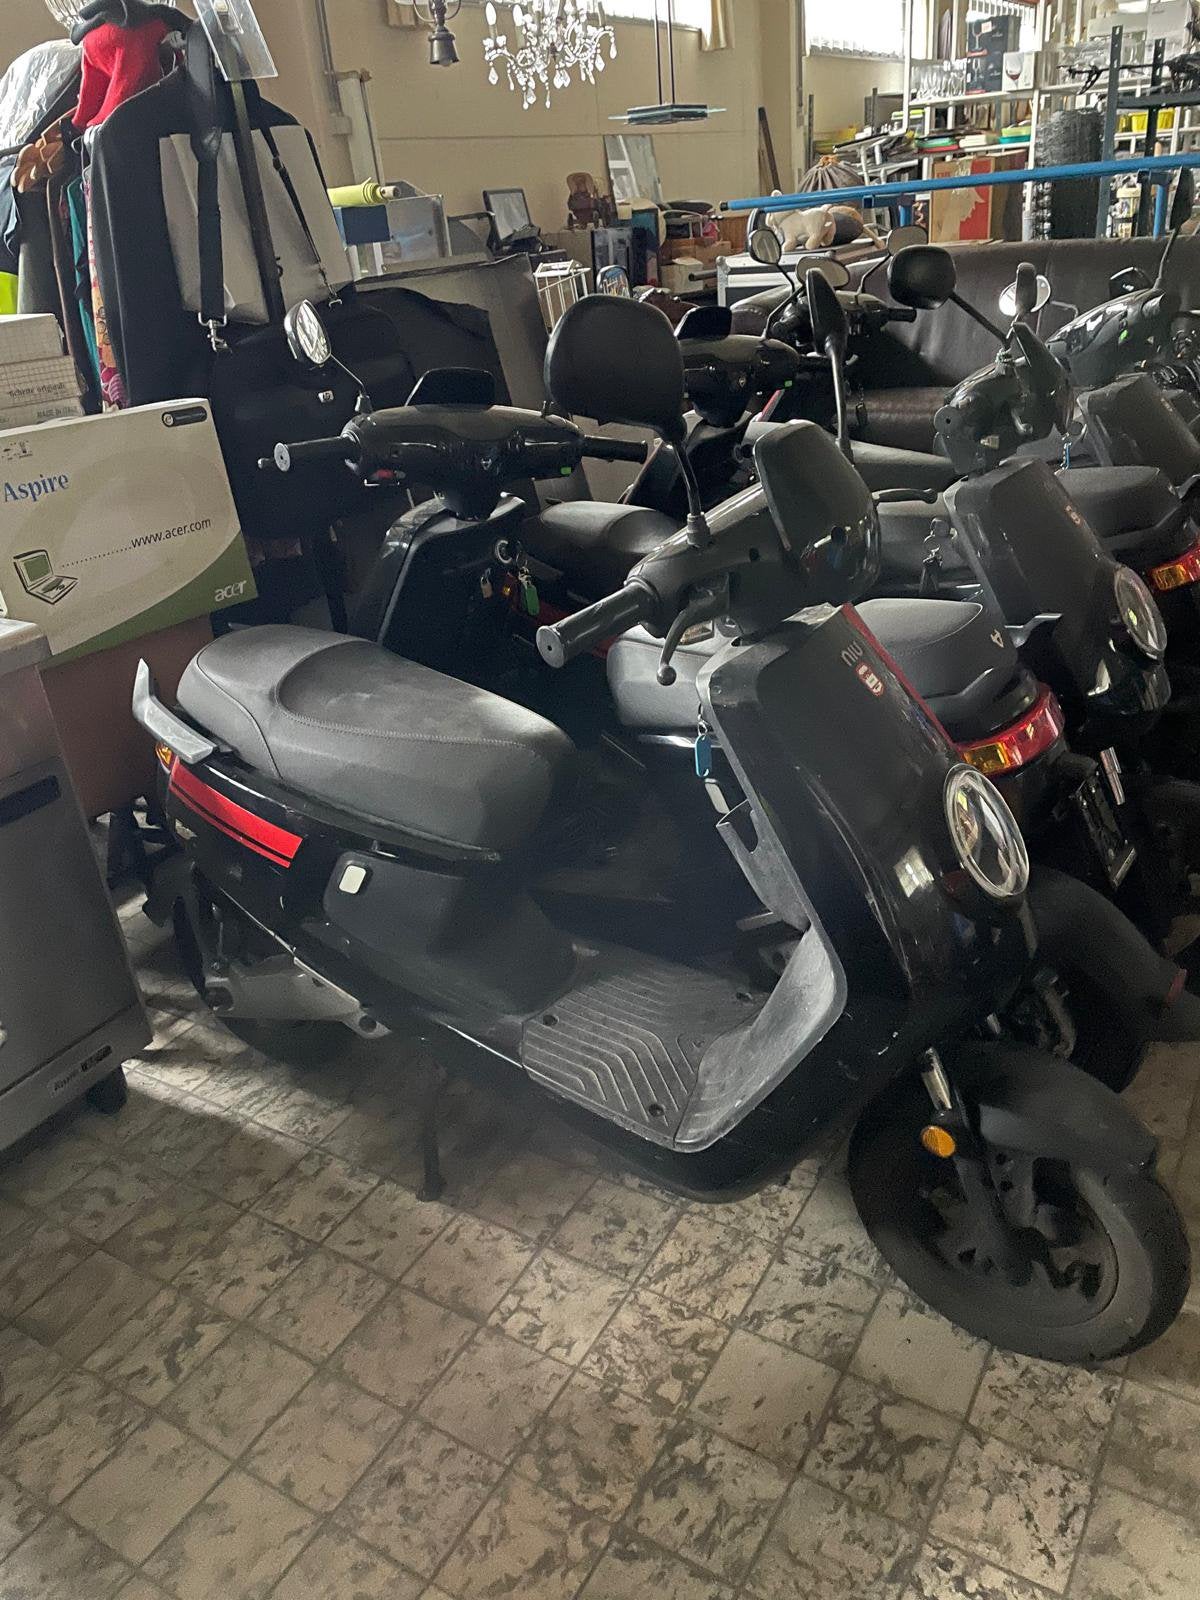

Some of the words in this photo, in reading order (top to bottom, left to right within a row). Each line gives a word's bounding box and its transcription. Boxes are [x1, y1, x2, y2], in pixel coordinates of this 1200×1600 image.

[4, 473, 69, 502] Aspire
[131, 519, 212, 548] www.acer.com
[214, 580, 247, 602] acer
